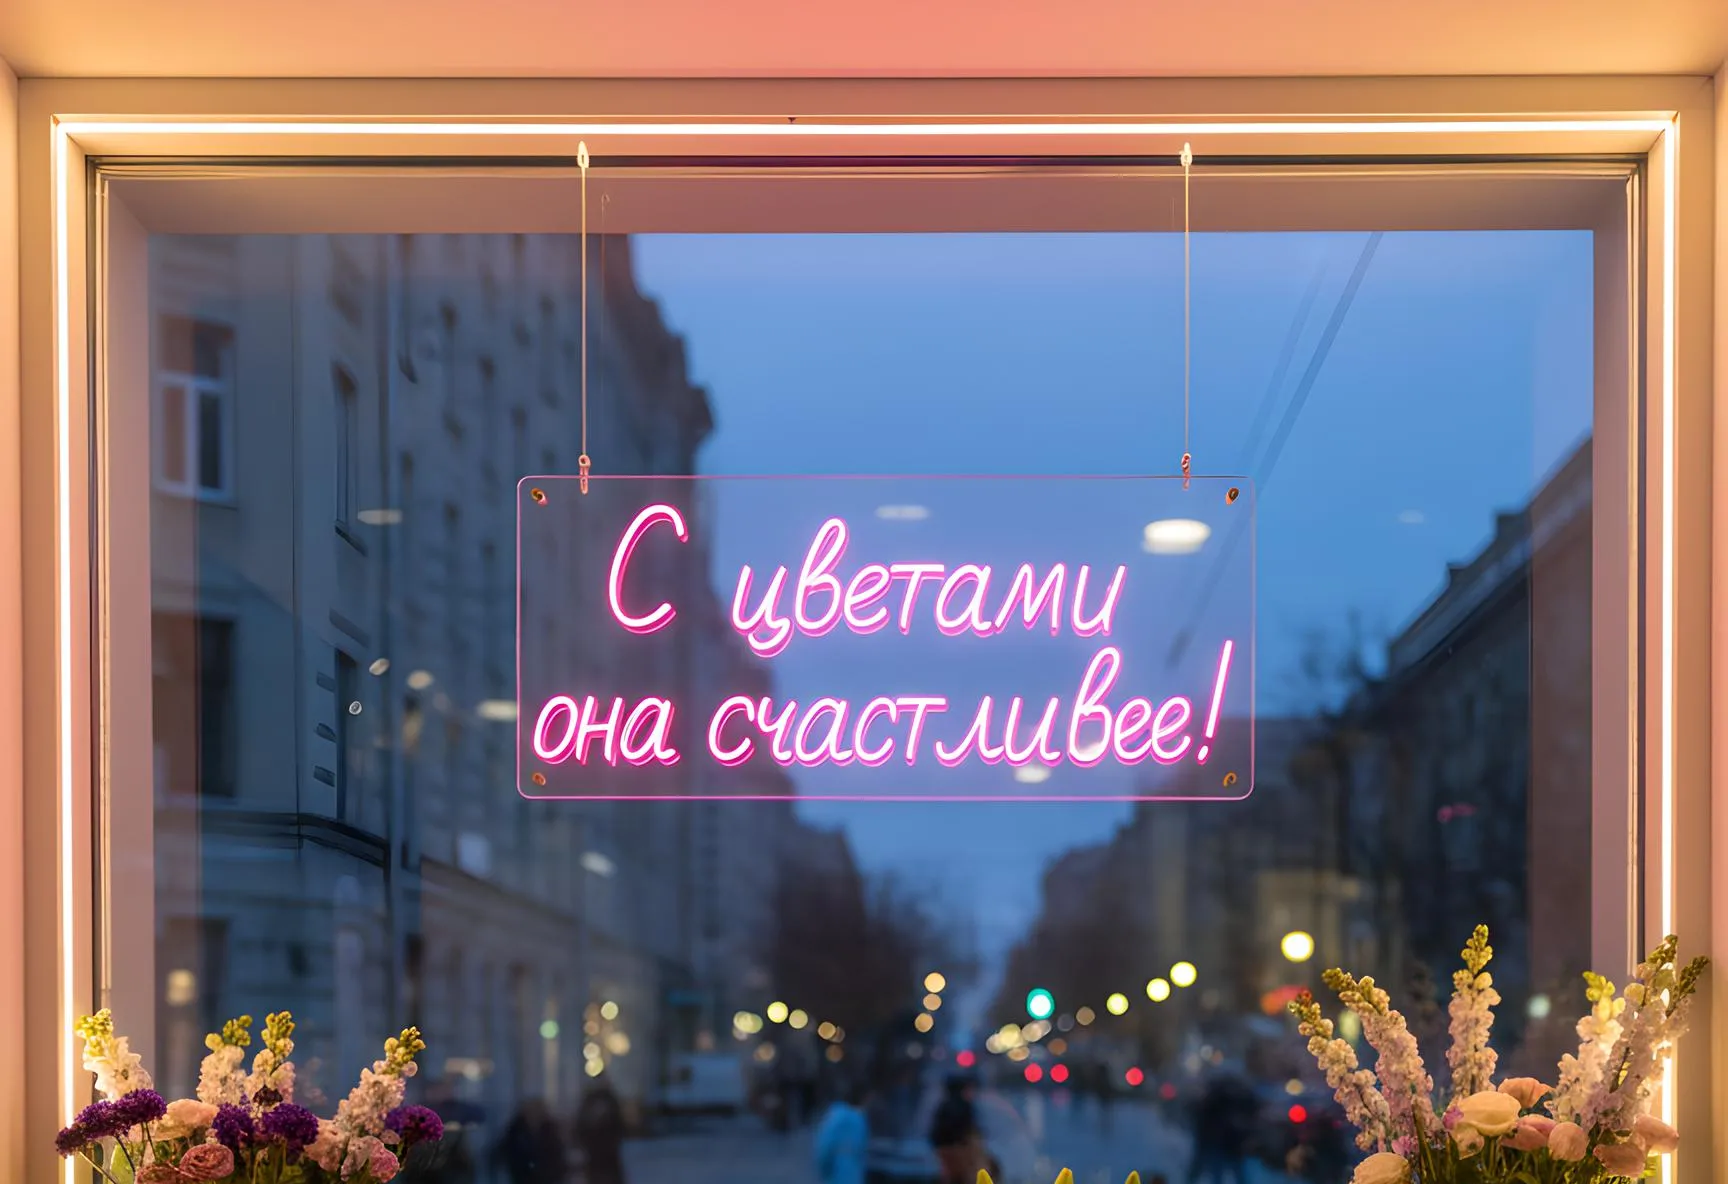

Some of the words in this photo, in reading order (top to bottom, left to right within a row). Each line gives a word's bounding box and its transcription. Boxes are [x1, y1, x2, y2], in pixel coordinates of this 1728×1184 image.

[607, 503, 689, 635] С
[730, 516, 1128, 658] цветами
[531, 695, 681, 768] она
[706, 638, 1235, 768] счастливее!
